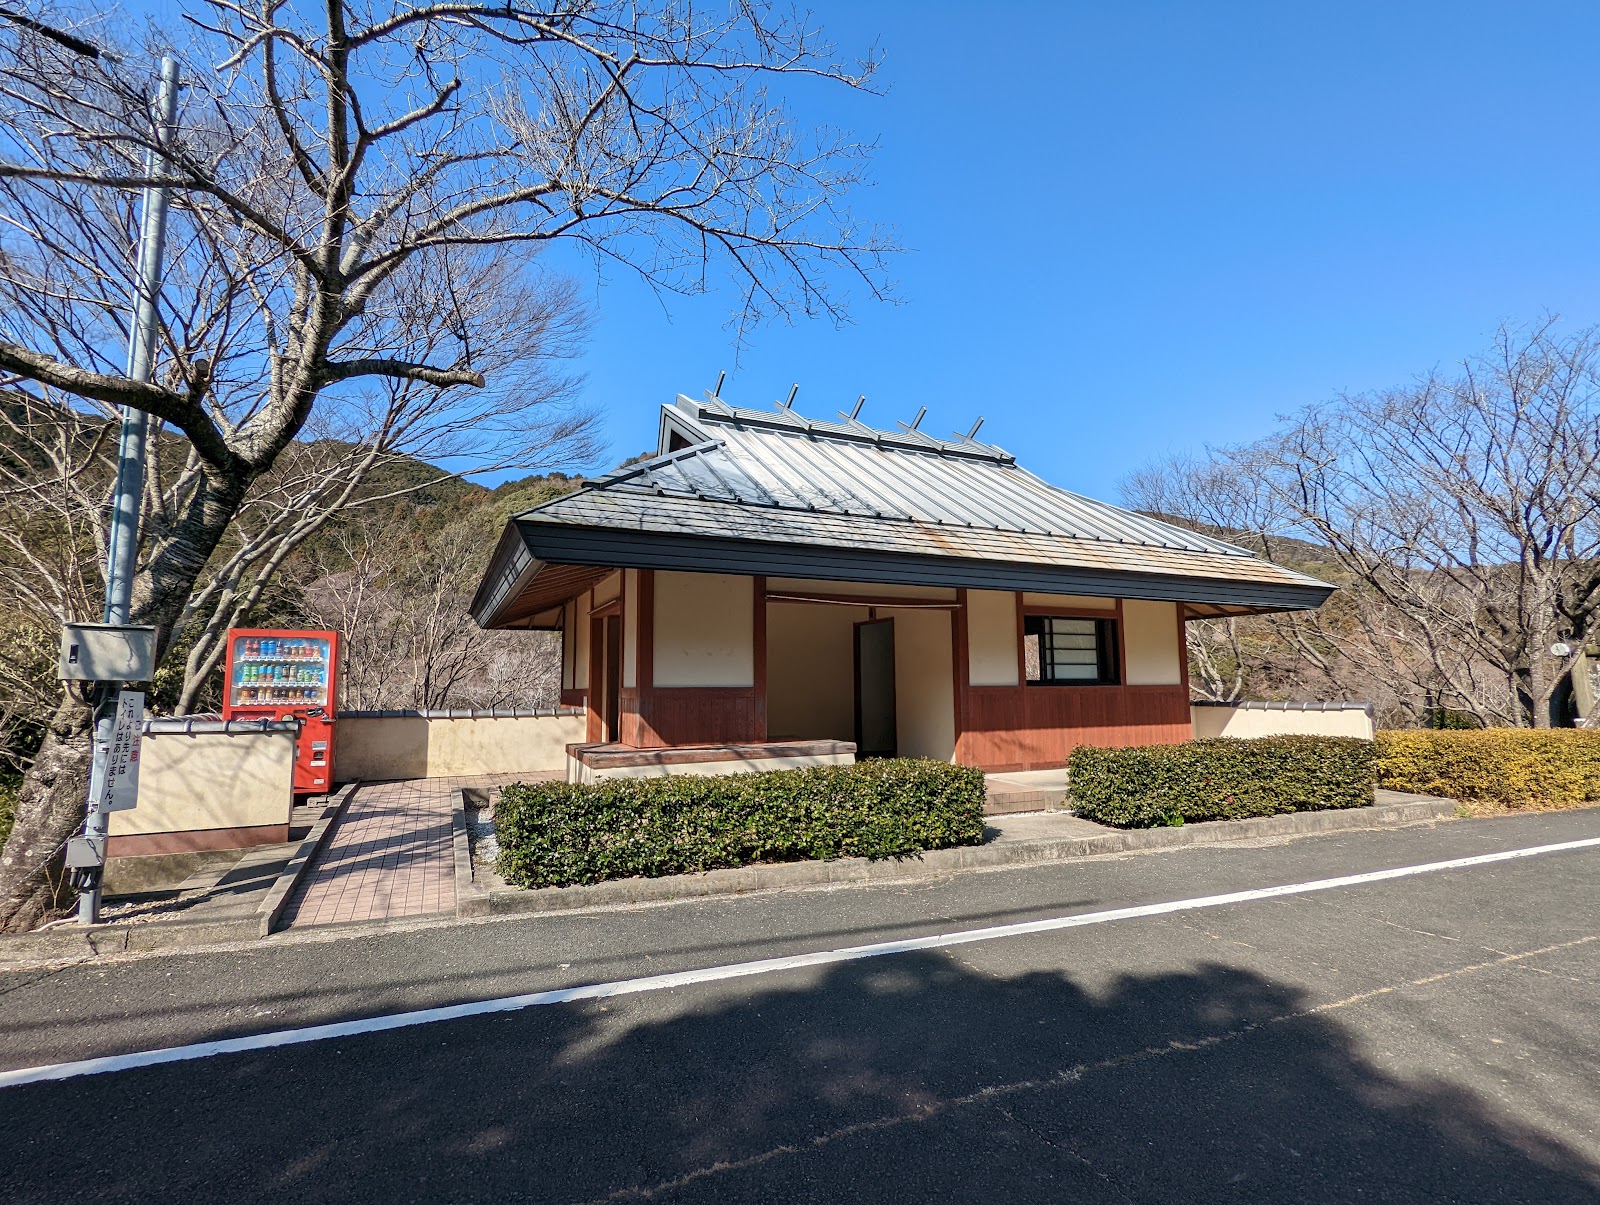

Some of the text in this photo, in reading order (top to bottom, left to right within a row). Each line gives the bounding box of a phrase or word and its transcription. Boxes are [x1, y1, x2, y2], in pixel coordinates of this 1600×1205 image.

[104, 697, 128, 805] トイレはありません。
[118, 698, 135, 775] これより先には
